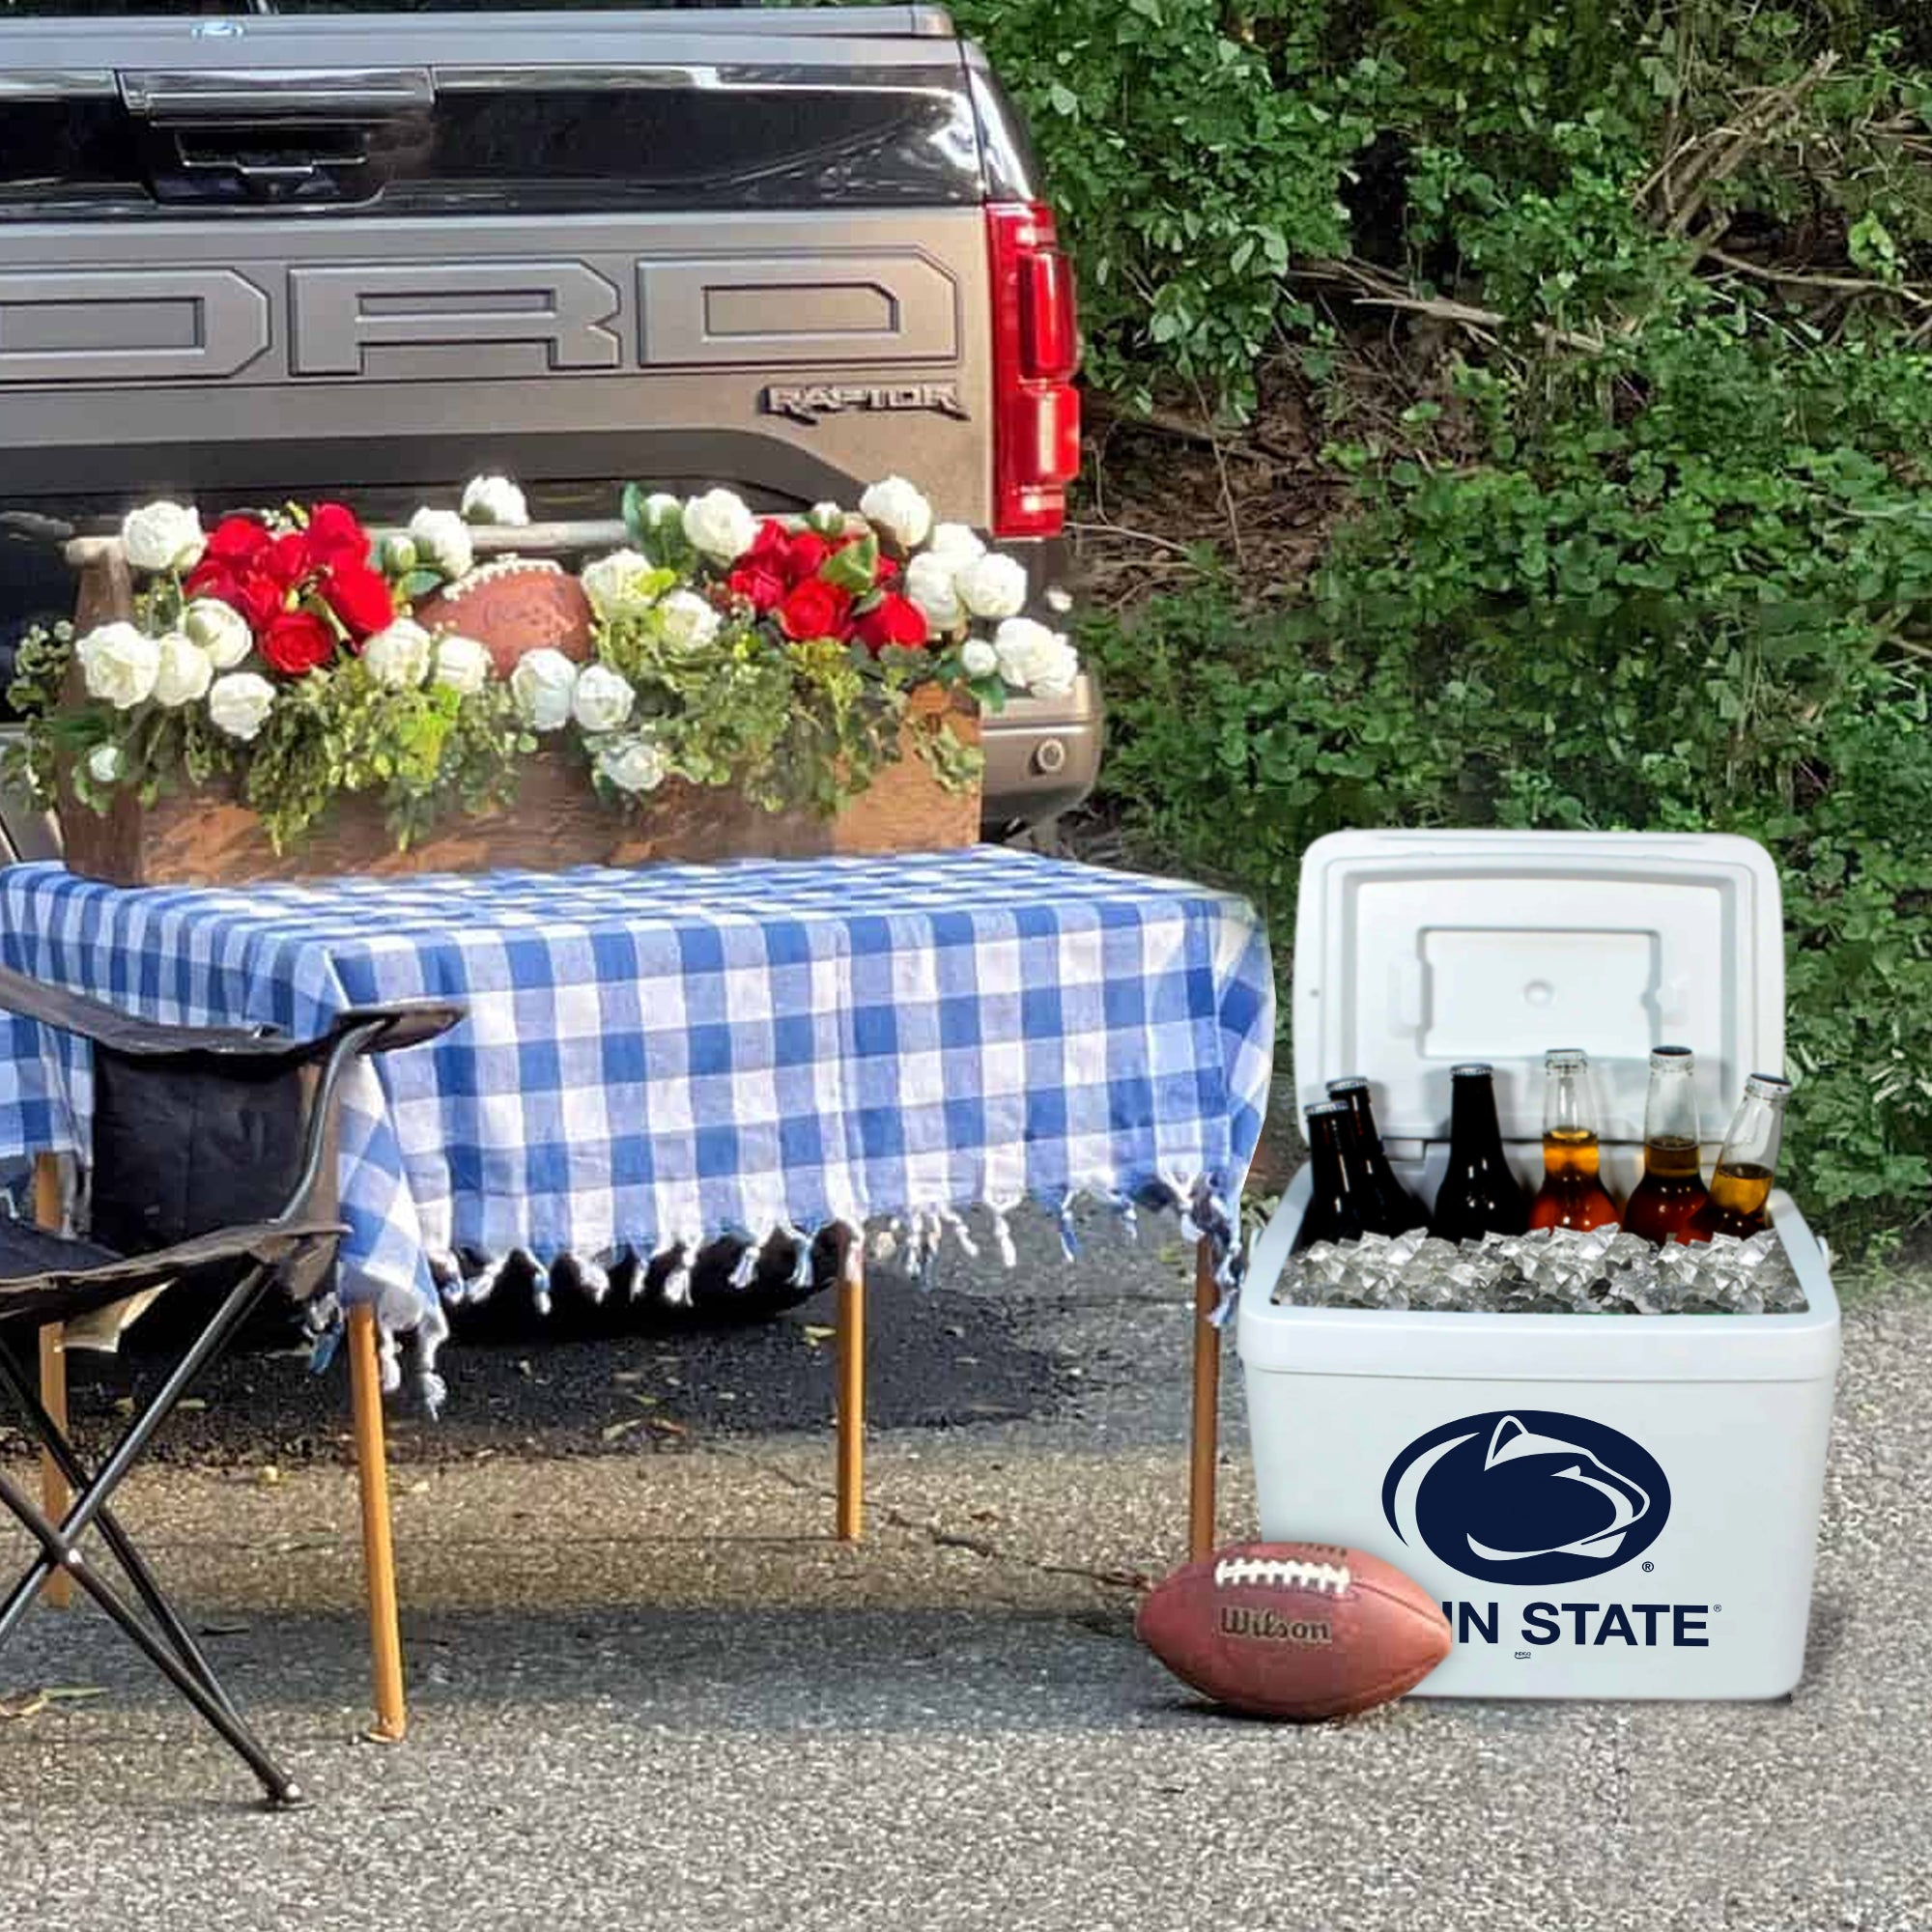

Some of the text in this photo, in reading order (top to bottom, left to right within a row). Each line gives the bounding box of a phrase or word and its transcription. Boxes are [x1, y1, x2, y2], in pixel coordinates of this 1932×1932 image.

[759, 385, 971, 426] RAPTOR
[1220, 1605, 1332, 1640] Wilson
[1441, 1601, 1710, 1647] N STATE
